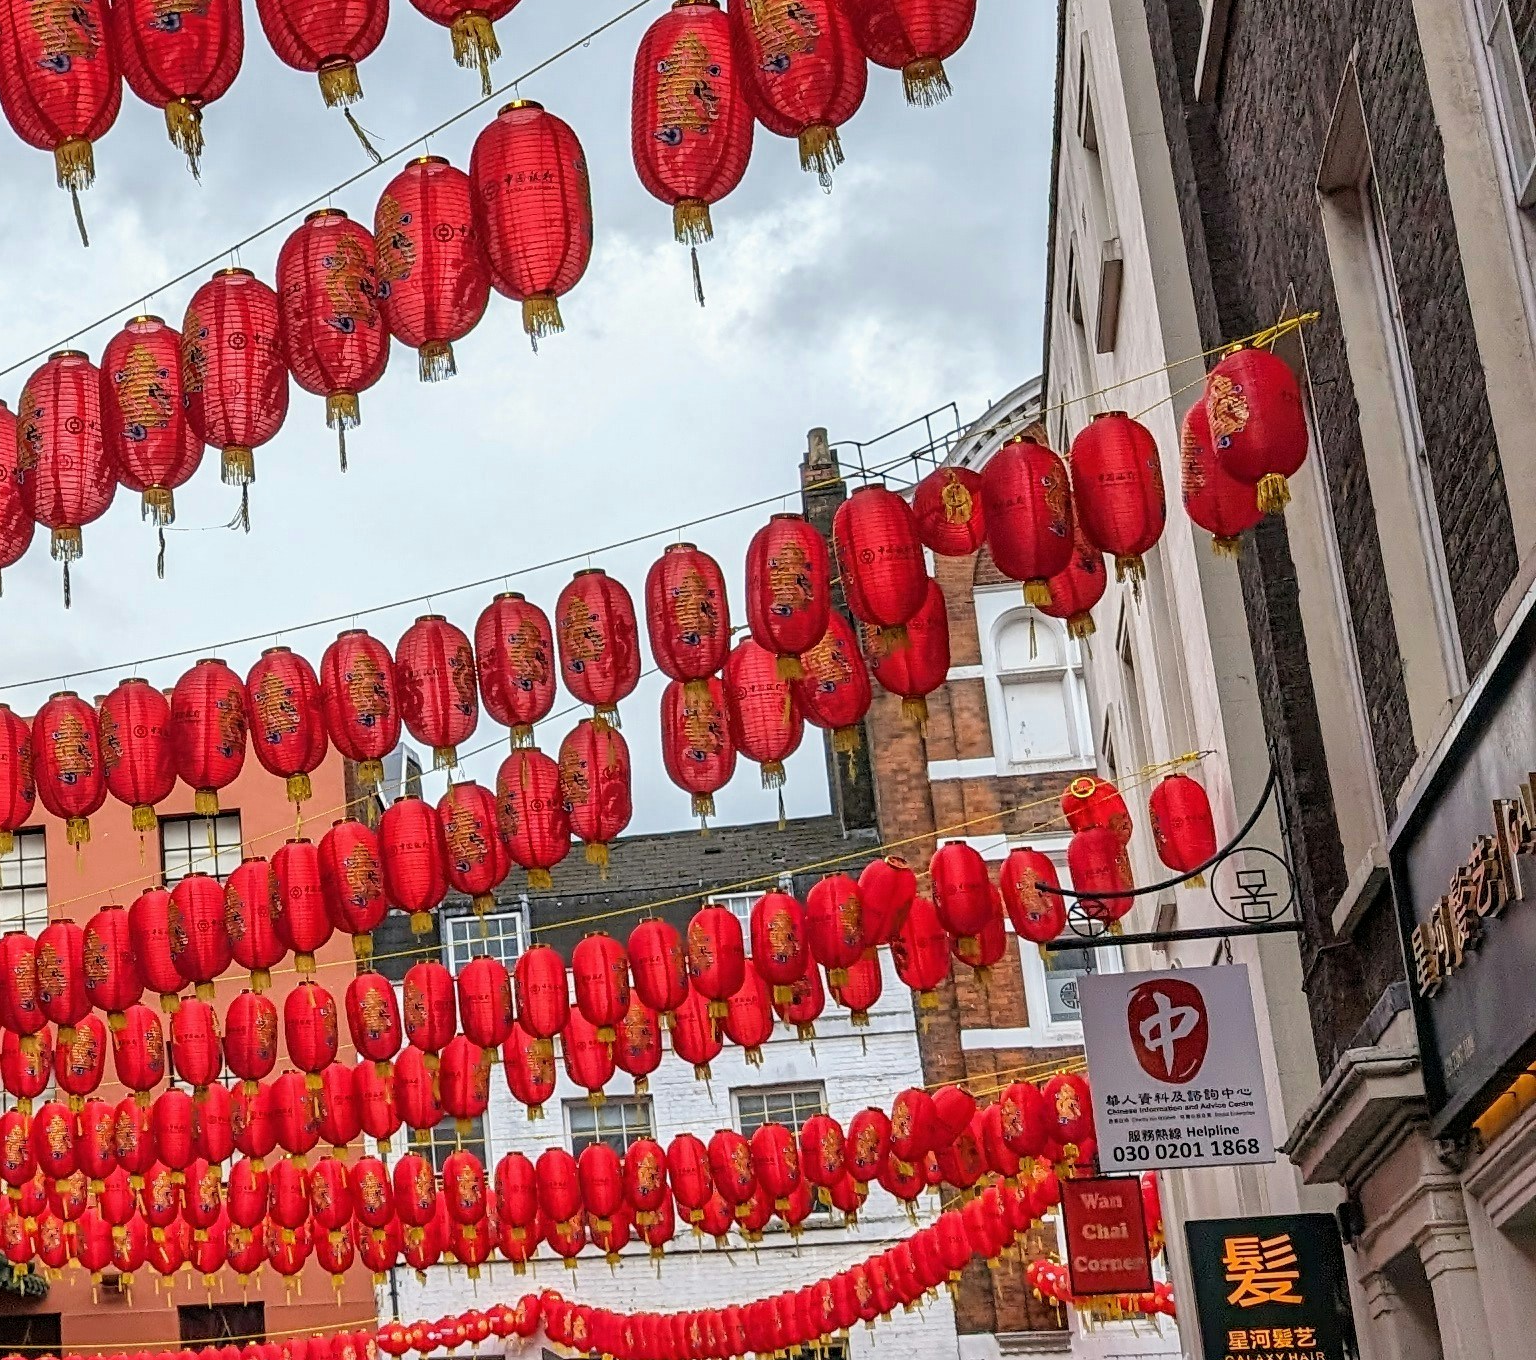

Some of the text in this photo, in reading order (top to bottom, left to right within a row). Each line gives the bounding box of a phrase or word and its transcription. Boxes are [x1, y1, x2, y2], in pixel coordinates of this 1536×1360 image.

[1139, 992, 1200, 1077] 中
[1107, 1100, 1254, 1116] Chinese Information and Advice Centre
[1128, 1125, 1240, 1143] 服務熱線 Helpline
[1113, 1138, 1260, 1163] 030 0201 1868
[1080, 1192, 1123, 1210] Wan
[1082, 1222, 1129, 1240] Chai
[1074, 1256, 1145, 1273] Corner
